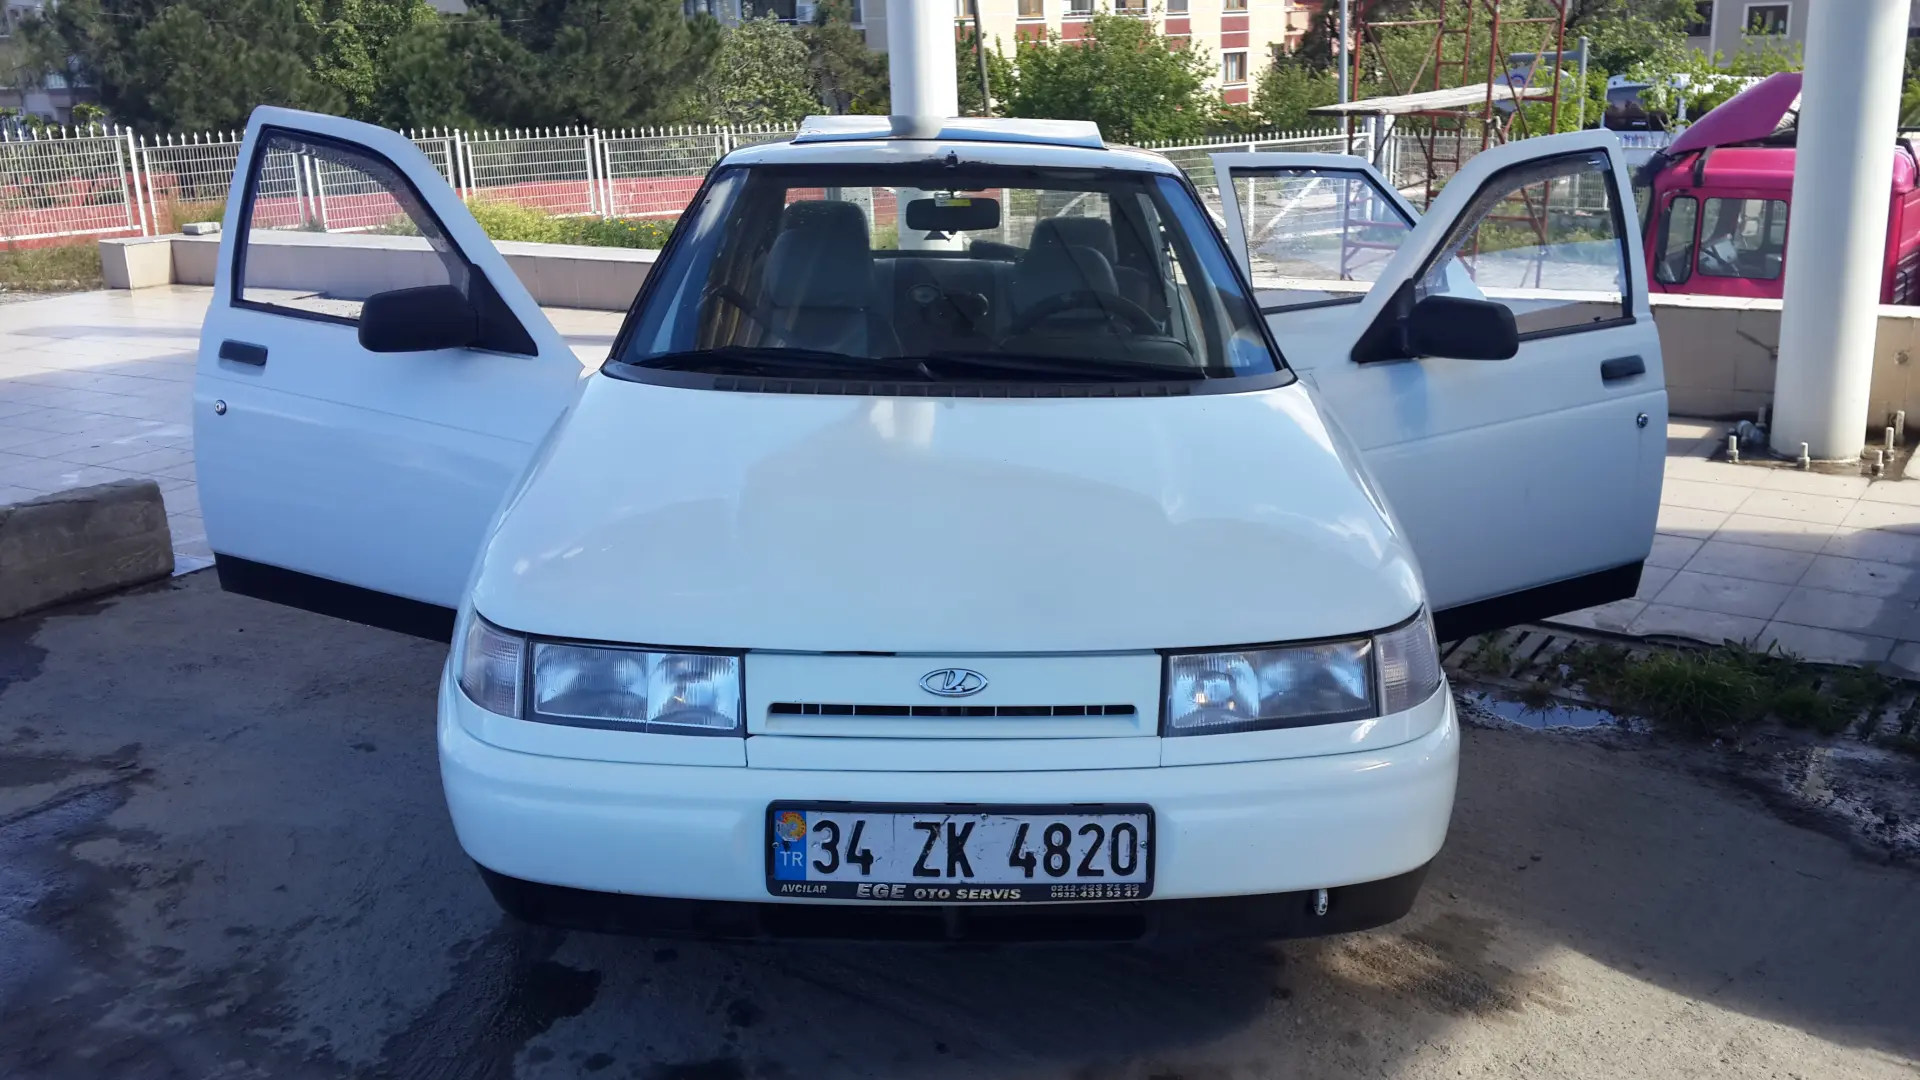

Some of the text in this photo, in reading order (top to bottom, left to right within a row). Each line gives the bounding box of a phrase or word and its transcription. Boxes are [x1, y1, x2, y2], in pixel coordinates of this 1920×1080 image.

[812, 820, 1138, 878] 34 ZK 4820
[780, 851, 803, 867] TR
[856, 883, 907, 899] EGE
[914, 888, 951, 899] OTO
